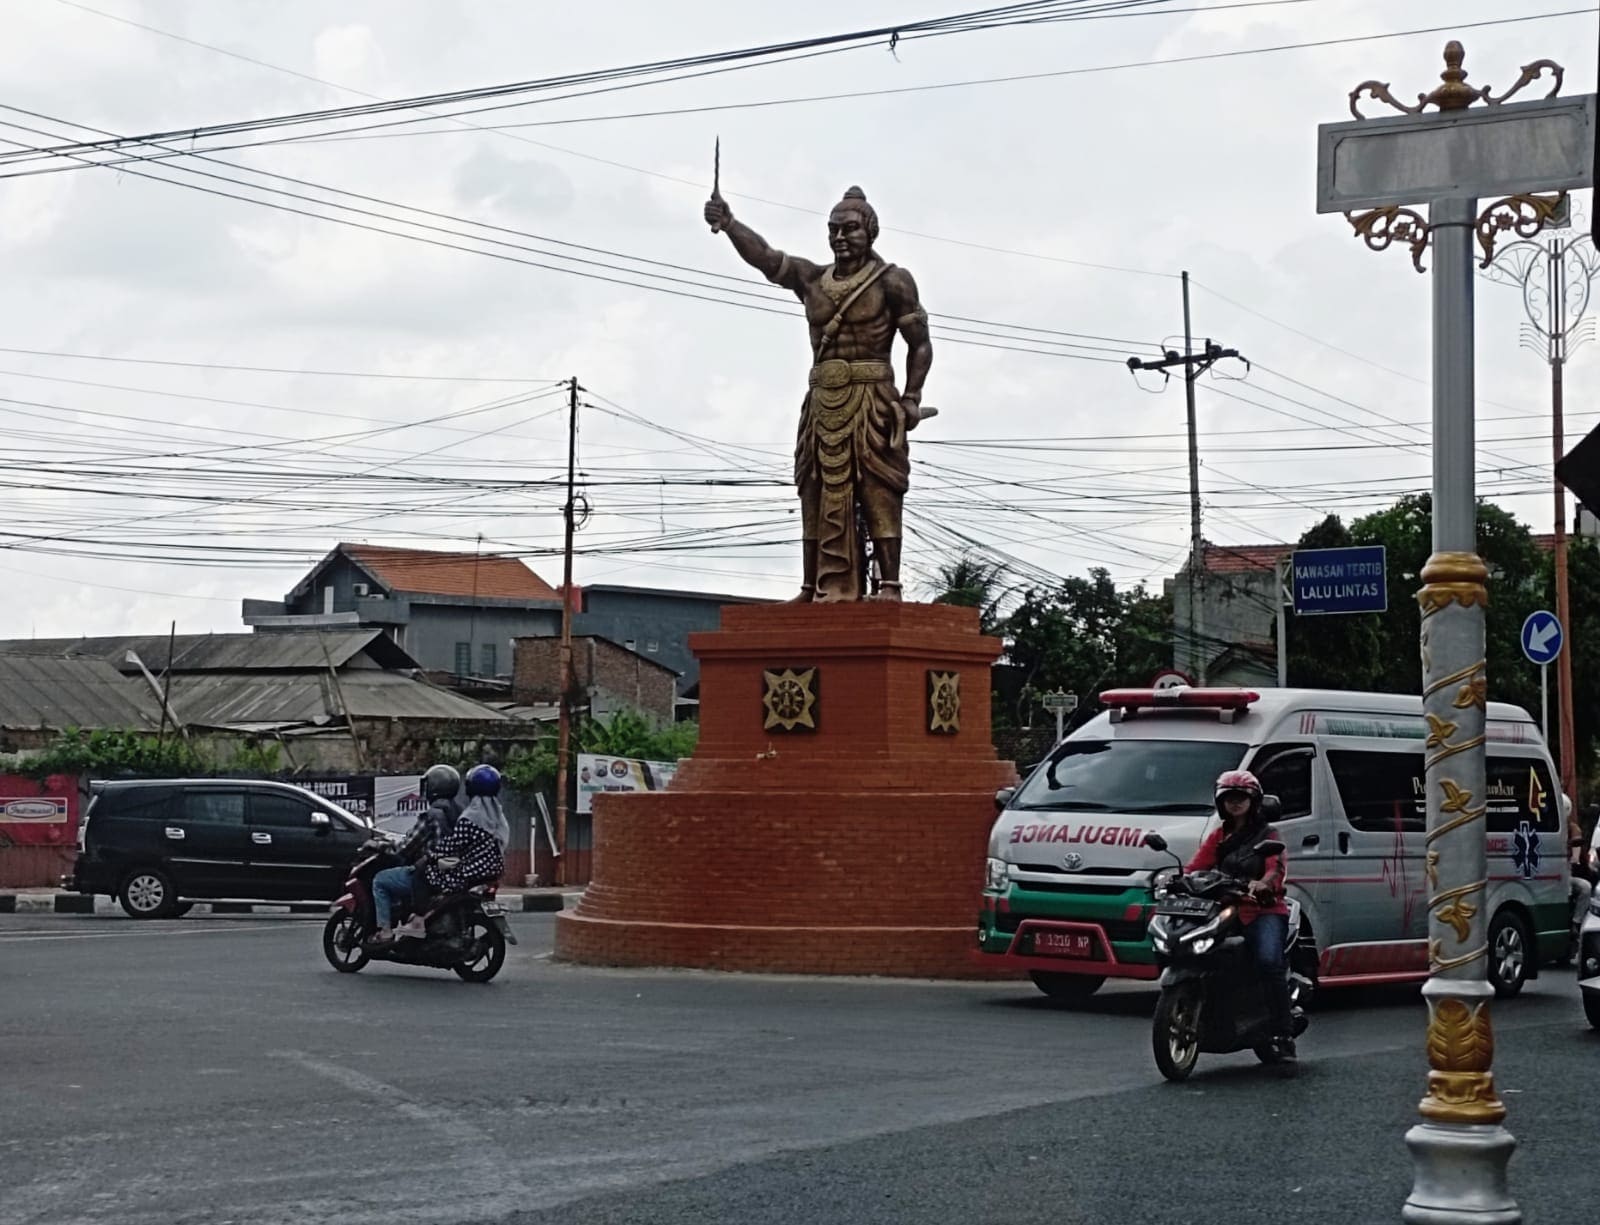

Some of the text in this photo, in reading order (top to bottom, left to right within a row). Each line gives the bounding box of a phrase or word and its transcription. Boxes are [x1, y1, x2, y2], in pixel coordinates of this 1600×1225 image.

[1295, 562, 1382, 579] KAWASAN TERTIB
[1301, 583, 1379, 600] LALU LINTAS
